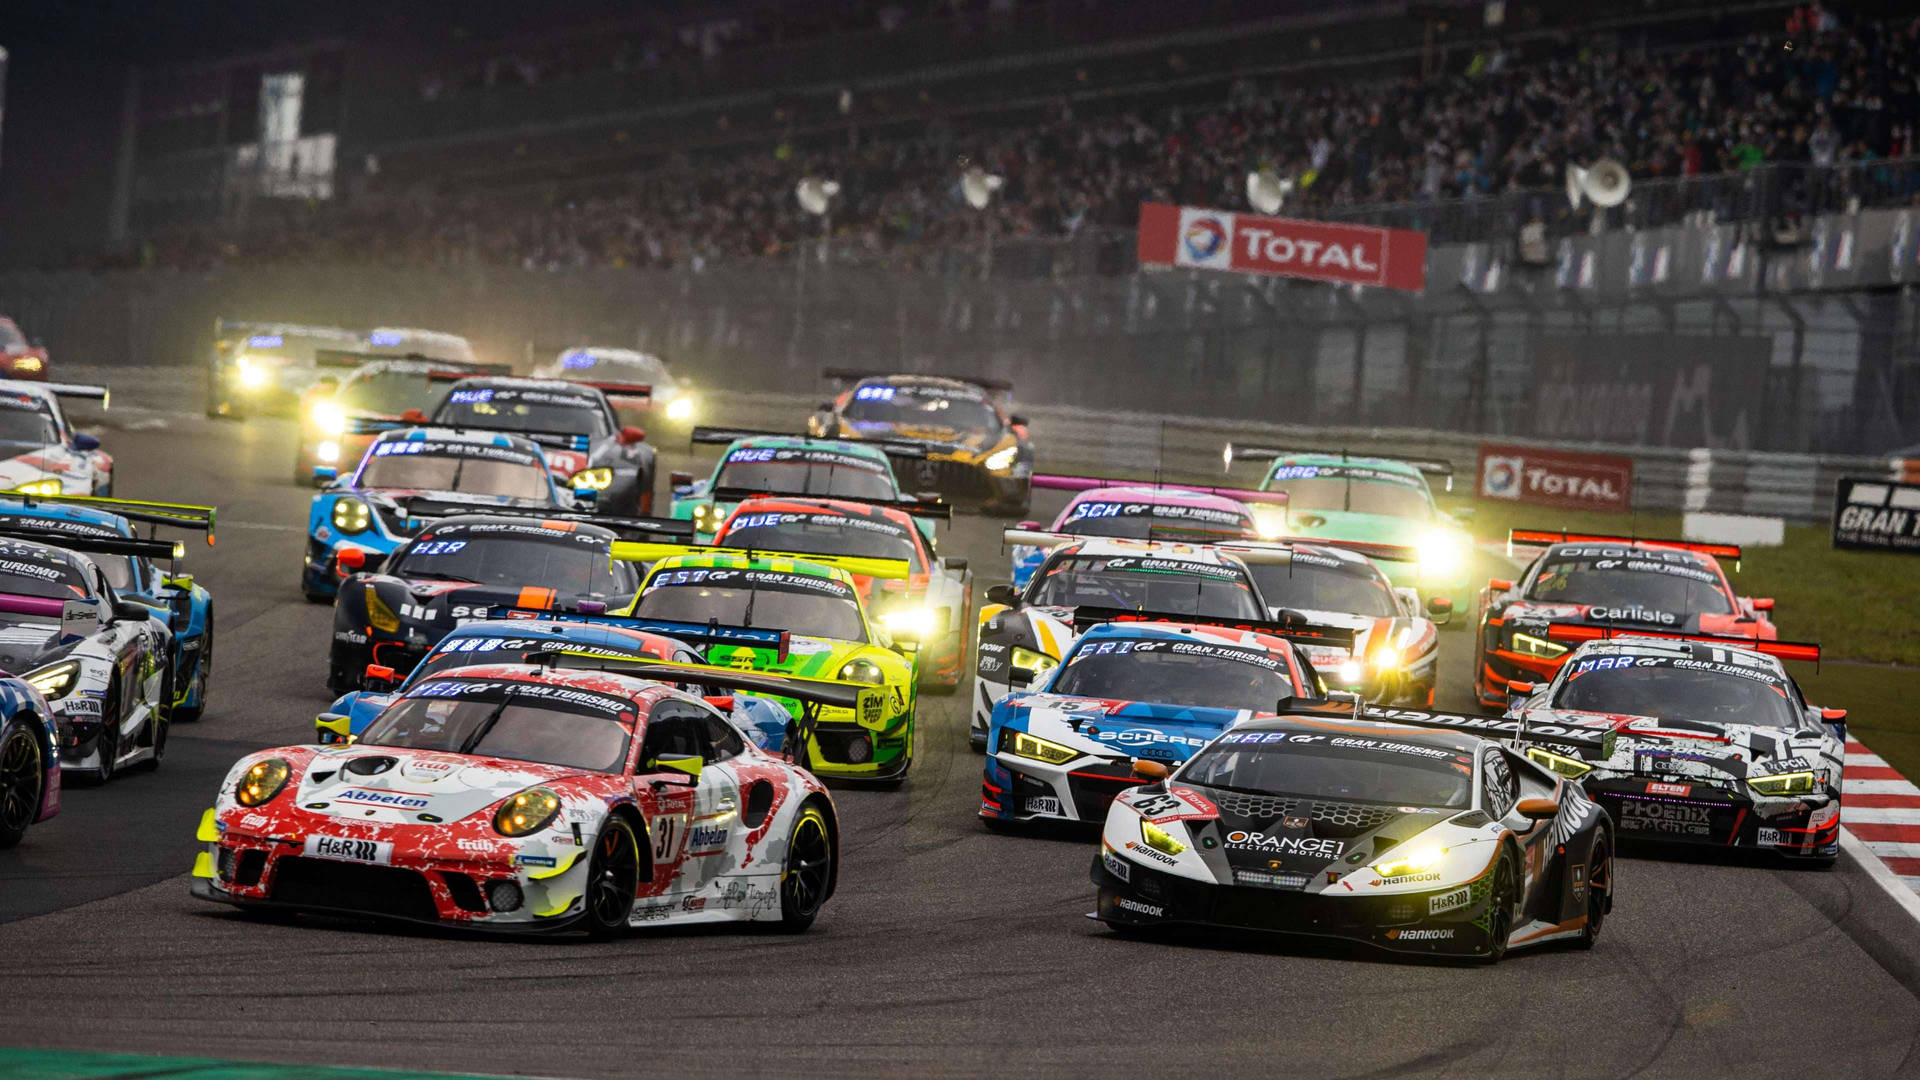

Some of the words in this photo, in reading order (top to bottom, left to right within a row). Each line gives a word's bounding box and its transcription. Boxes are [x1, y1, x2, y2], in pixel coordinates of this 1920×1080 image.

[1240, 227, 1378, 272] TOTAL
[1523, 467, 1621, 500] TOTAL
[1073, 503, 1121, 519] SCH
[1153, 506, 1187, 515] GRAN
[1188, 508, 1240, 523] TURISMO
[1840, 506, 1907, 535] GRAN
[470, 524, 506, 533] GRAN
[509, 525, 567, 537] TURISMO
[411, 540, 467, 555] HIR
[1141, 560, 1179, 569] GRAN
[1180, 562, 1239, 577] TURISMO
[1292, 553, 1341, 567] URISMO
[1628, 561, 1661, 571] GRAN
[746, 572, 785, 582] GRAN
[787, 575, 847, 595] TURISMO
[1589, 605, 1676, 625] Carlisle
[541, 641, 583, 653] GRAN
[1077, 641, 1135, 657] FRI
[1172, 643, 1214, 654] GRAN
[1216, 647, 1278, 667] TURISMO
[1577, 656, 1634, 673] MAR
[1673, 658, 1712, 669] GRAN
[1714, 663, 1776, 684] TURISMO
[64, 700, 88, 711] H&R
[504, 684, 555, 695] GRAN
[557, 688, 627, 712] TURISMO
[1330, 737, 1377, 748] GRAN
[1379, 741, 1449, 758] TURISMO
[1779, 757, 1808, 770] PCH
[1651, 783, 1686, 793] ELTEN
[337, 790, 429, 808] Abbelen
[1132, 795, 1182, 816] 63
[1187, 794, 1211, 812] TOTAL
[656, 816, 674, 859] 31
[691, 824, 728, 847] Abbelen
[1226, 830, 1344, 854] ORANGE1
[1759, 830, 1779, 842] H&R
[318, 837, 353, 855] H&R
[1224, 843, 1286, 854] ELECTRIC
[1287, 848, 1340, 861] MOTORS
[1431, 895, 1455, 911] H&R
